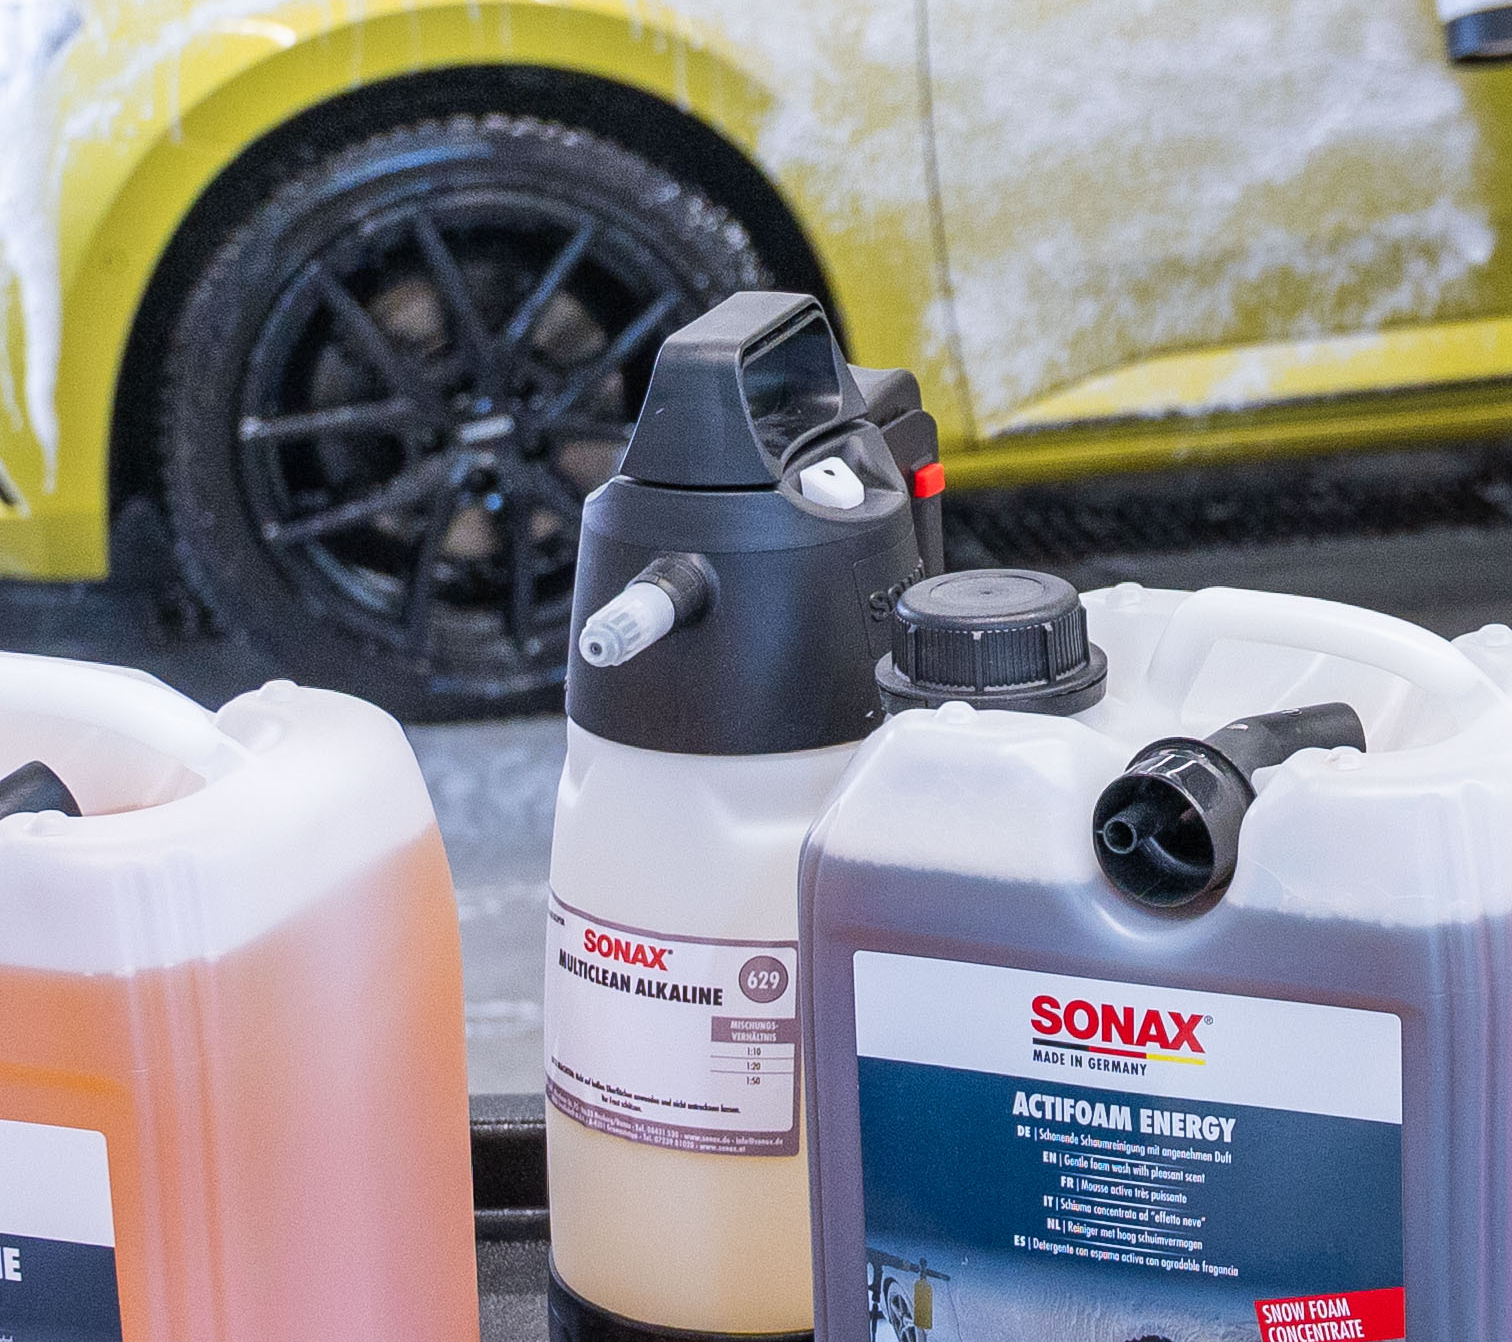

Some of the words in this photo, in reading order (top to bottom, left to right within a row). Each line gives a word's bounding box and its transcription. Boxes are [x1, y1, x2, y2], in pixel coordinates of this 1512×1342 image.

[584, 928, 668, 971] SONAX
[559, 948, 631, 993] MULTICLEAN
[635, 978, 723, 1006] ALKALINE
[747, 970, 780, 990] 629
[730, 1020, 779, 1030] MISCHUNGS-
[1030, 995, 1206, 1053] SONAX
[747, 1047, 761, 1056] 1:10
[1032, 1049, 1065, 1068] MADE
[1070, 1053, 1083, 1069] IN
[1087, 1056, 1147, 1076] GERMANY
[746, 1077, 761, 1085] 1:50
[747, 1062, 761, 1071] 1:20
[1012, 1091, 1132, 1131] ACTIFOAM
[1140, 1108, 1236, 1143] ENERGY
[1017, 1125, 1031, 1138] DE
[1039, 1127, 1079, 1145] Schonende
[1080, 1134, 1145, 1157] Schaumreinigung
[1147, 1144, 1159, 1156] mit
[1162, 1147, 1212, 1162] angenehmen
[1215, 1151, 1232, 1164] Duft
[1042, 1151, 1057, 1163] EN
[1064, 1154, 1089, 1168] Gentle
[1090, 1157, 1110, 1172] foam
[1111, 1161, 1131, 1175] wash
[1132, 1164, 1149, 1177] with
[1151, 1166, 1184, 1181] pleasant
[1185, 1172, 1205, 1184] scent
[1060, 1175, 1074, 1188] FR
[1081, 1179, 1109, 1194] Mousse
[1110, 1184, 1133, 1197] active
[1134, 1187, 1150, 1199] très
[1150, 1190, 1187, 1204] puissante
[1046, 1218, 1061, 1230] NL
[1068, 1221, 1098, 1238] Reiniger
[1100, 1227, 1115, 1239] met
[1117, 1228, 1136, 1244] hoog
[1138, 1232, 1203, 1251] schuimvermogen
[1262, 1300, 1305, 1324] SNOW
[1308, 1298, 1350, 1320] FOAM
